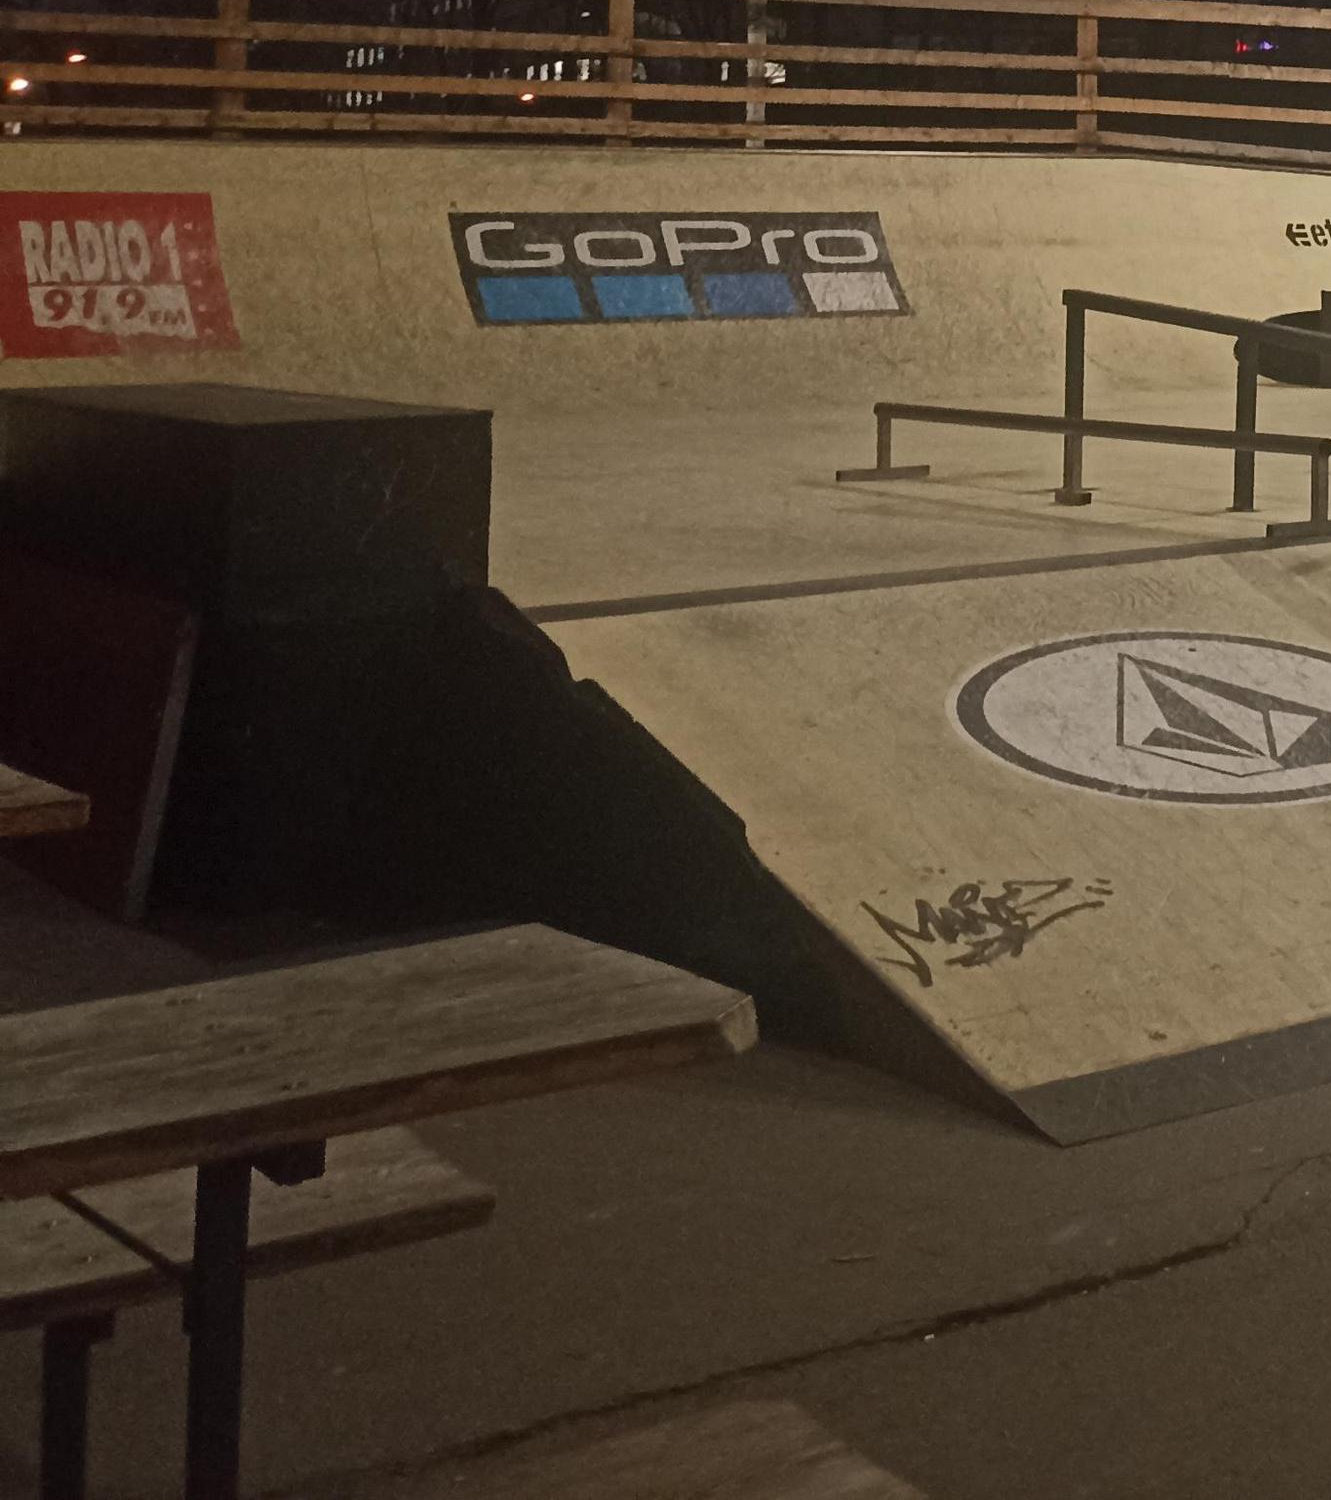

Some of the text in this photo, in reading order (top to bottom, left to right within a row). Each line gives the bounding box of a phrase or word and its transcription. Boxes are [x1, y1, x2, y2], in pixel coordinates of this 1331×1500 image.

[19, 219, 183, 284] RADIO 1
[465, 220, 879, 269] GoPro
[151, 308, 187, 326] FM
